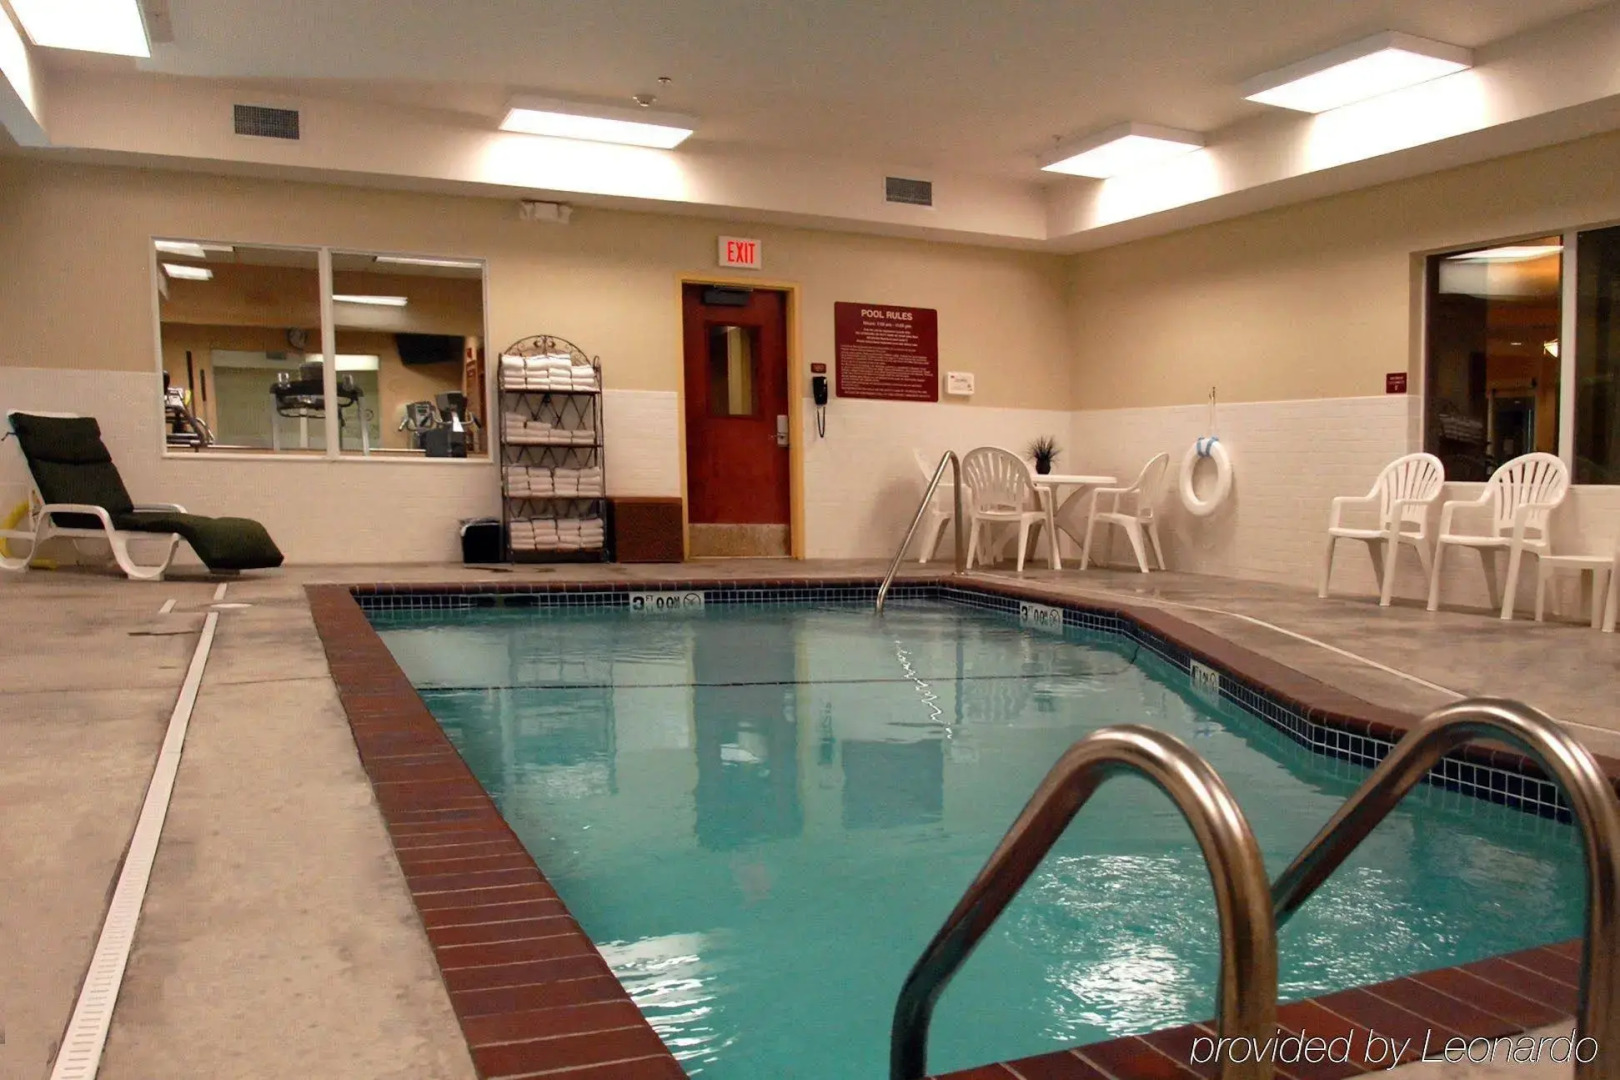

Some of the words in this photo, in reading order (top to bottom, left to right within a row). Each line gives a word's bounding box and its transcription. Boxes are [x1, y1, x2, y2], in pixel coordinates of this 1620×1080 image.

[727, 241, 755, 264] EXIT
[861, 309, 884, 319] POOL
[886, 311, 913, 321] RULES
